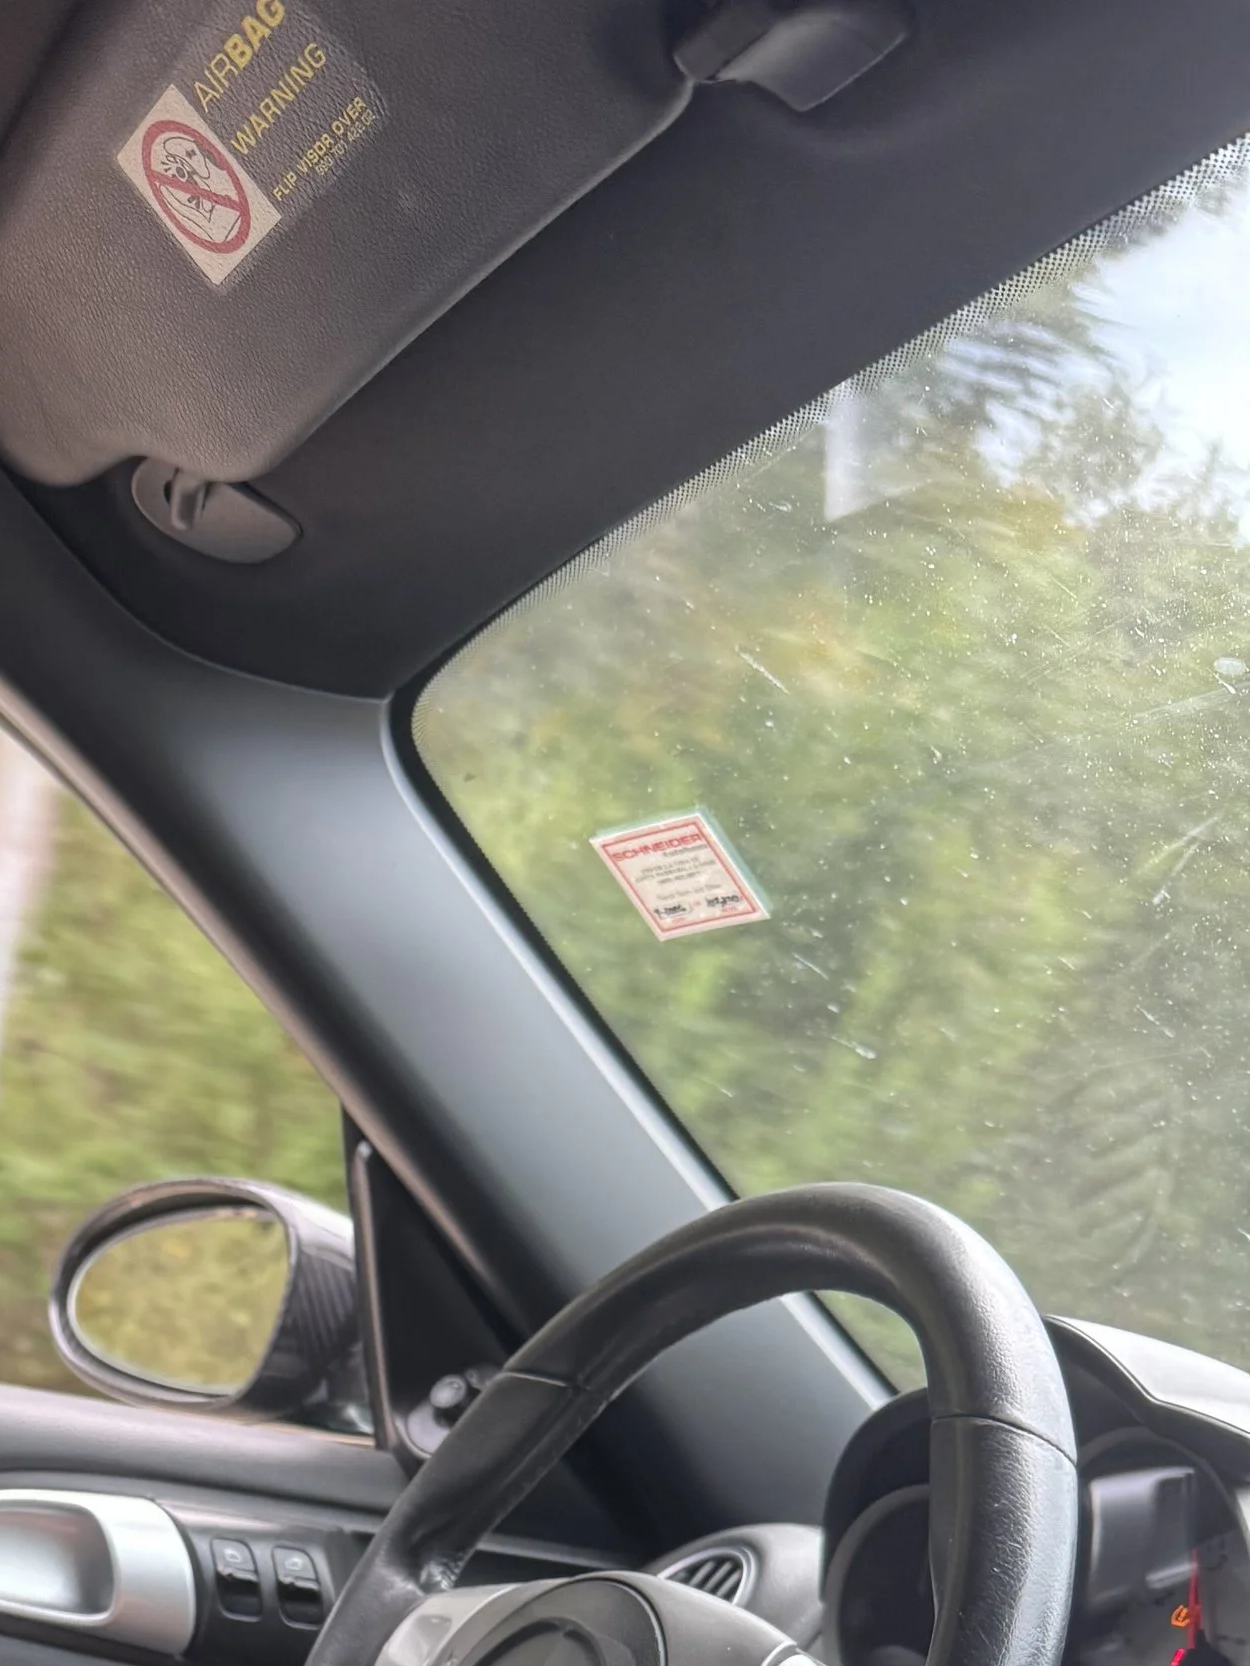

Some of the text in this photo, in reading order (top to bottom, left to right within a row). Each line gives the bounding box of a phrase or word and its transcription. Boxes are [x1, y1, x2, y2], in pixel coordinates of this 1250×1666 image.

[192, 0, 287, 113] AIRBAG
[230, 42, 327, 156] WARNING
[272, 96, 367, 201] FLIP VISOR OVER
